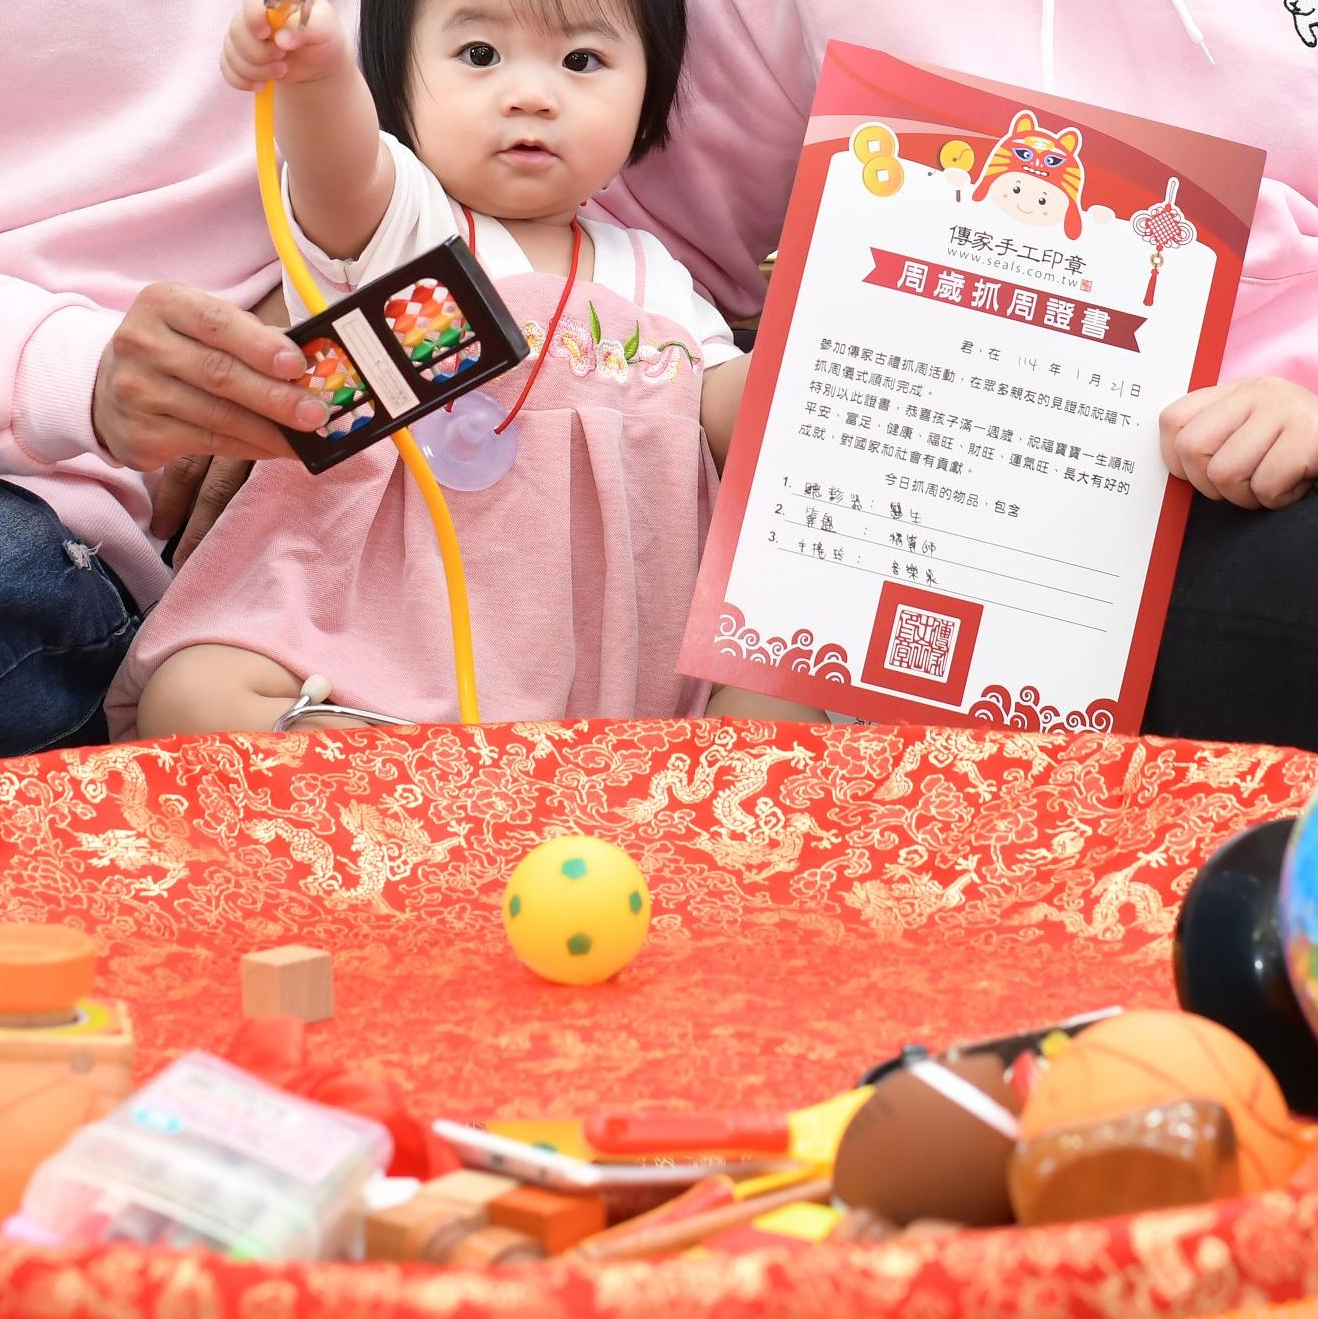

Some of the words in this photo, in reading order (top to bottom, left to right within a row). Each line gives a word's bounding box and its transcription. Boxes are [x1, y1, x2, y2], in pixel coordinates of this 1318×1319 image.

[947, 247, 1079, 288] www.seals.com.tw
[949, 224, 1086, 277] 傳家手工印章
[895, 260, 1112, 340] 周歲抓周證書
[813, 358, 933, 398] 抓周儀式順利完成。
[1048, 362, 1062, 377] 年
[1088, 373, 1101, 388] 月
[1129, 383, 1142, 398] 日
[798, 423, 973, 475] 成就，對國家和社會有貢獻。
[782, 476, 792, 489] 1.
[884, 472, 1021, 518] 今日抓周的物品，包含
[774, 503, 786, 516] 2.
[767, 530, 779, 544] 3.
